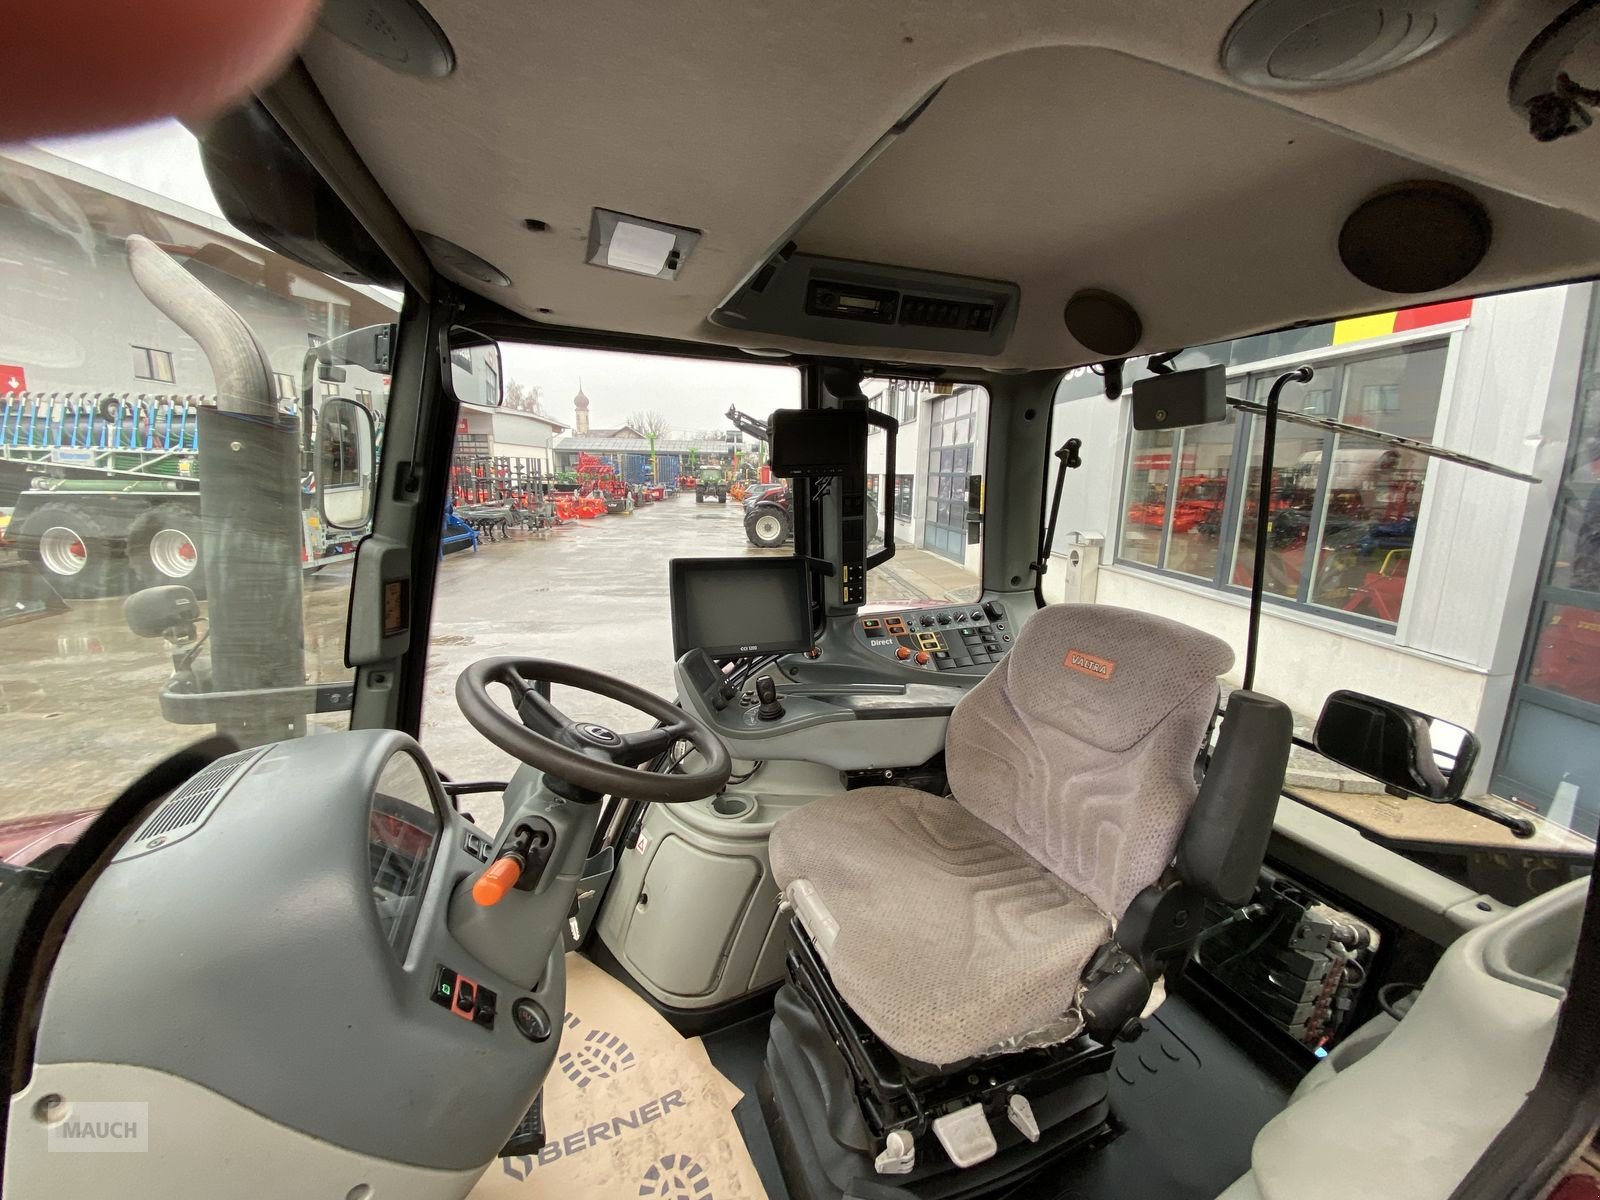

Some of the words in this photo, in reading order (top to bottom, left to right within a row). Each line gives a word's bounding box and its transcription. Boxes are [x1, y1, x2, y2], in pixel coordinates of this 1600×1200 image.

[870, 639, 893, 647] Direct
[1072, 655, 1107, 674] VALTRA
[538, 1089, 687, 1166] BERNER
